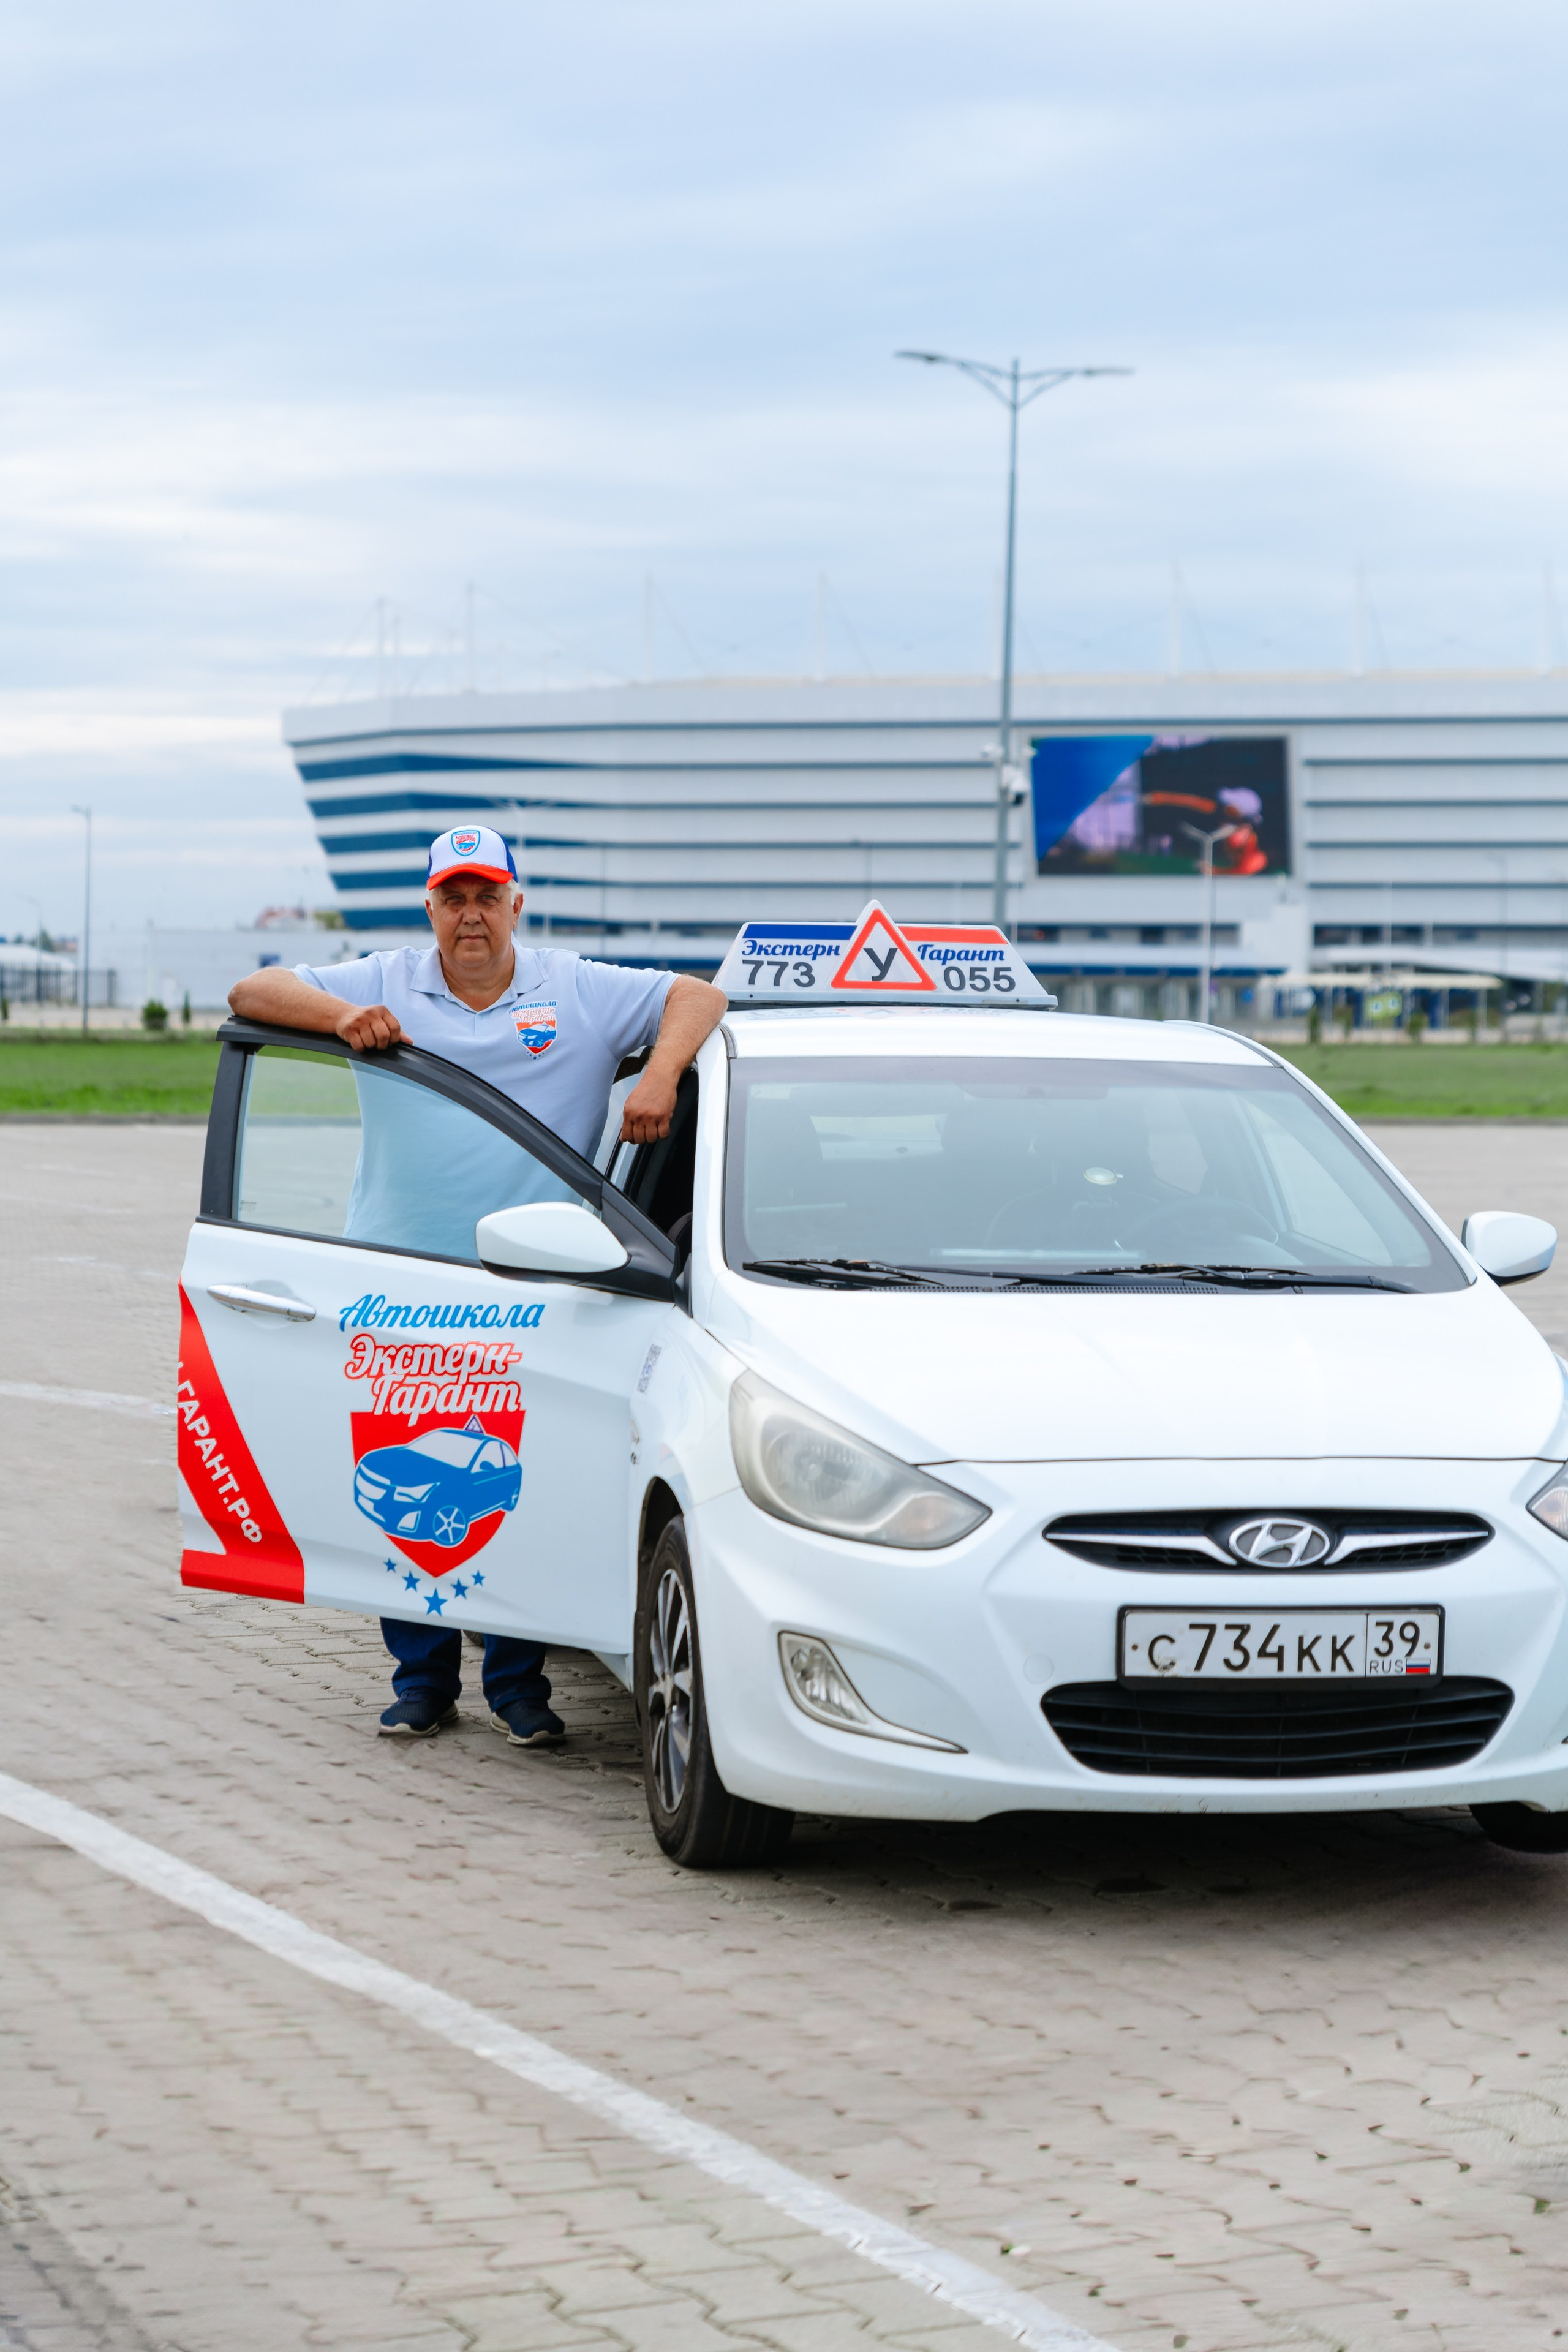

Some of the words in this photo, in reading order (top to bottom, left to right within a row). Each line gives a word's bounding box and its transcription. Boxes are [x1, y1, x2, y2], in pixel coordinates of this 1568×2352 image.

[741, 940, 840, 961] Экстерн
[918, 944, 1005, 965] Гарант
[863, 948, 898, 981] У
[742, 960, 816, 987] 773
[943, 966, 1016, 992] 055
[339, 1294, 546, 1332] Автошкола
[344, 1333, 524, 1385] Экстерн-
[371, 1373, 523, 1427] Гарант
[178, 1363, 262, 1542] ГАРАНТ.РФ
[1148, 1623, 1355, 1673] С734КК
[1374, 1621, 1420, 1657] 39
[1370, 1660, 1403, 1673] RUS
